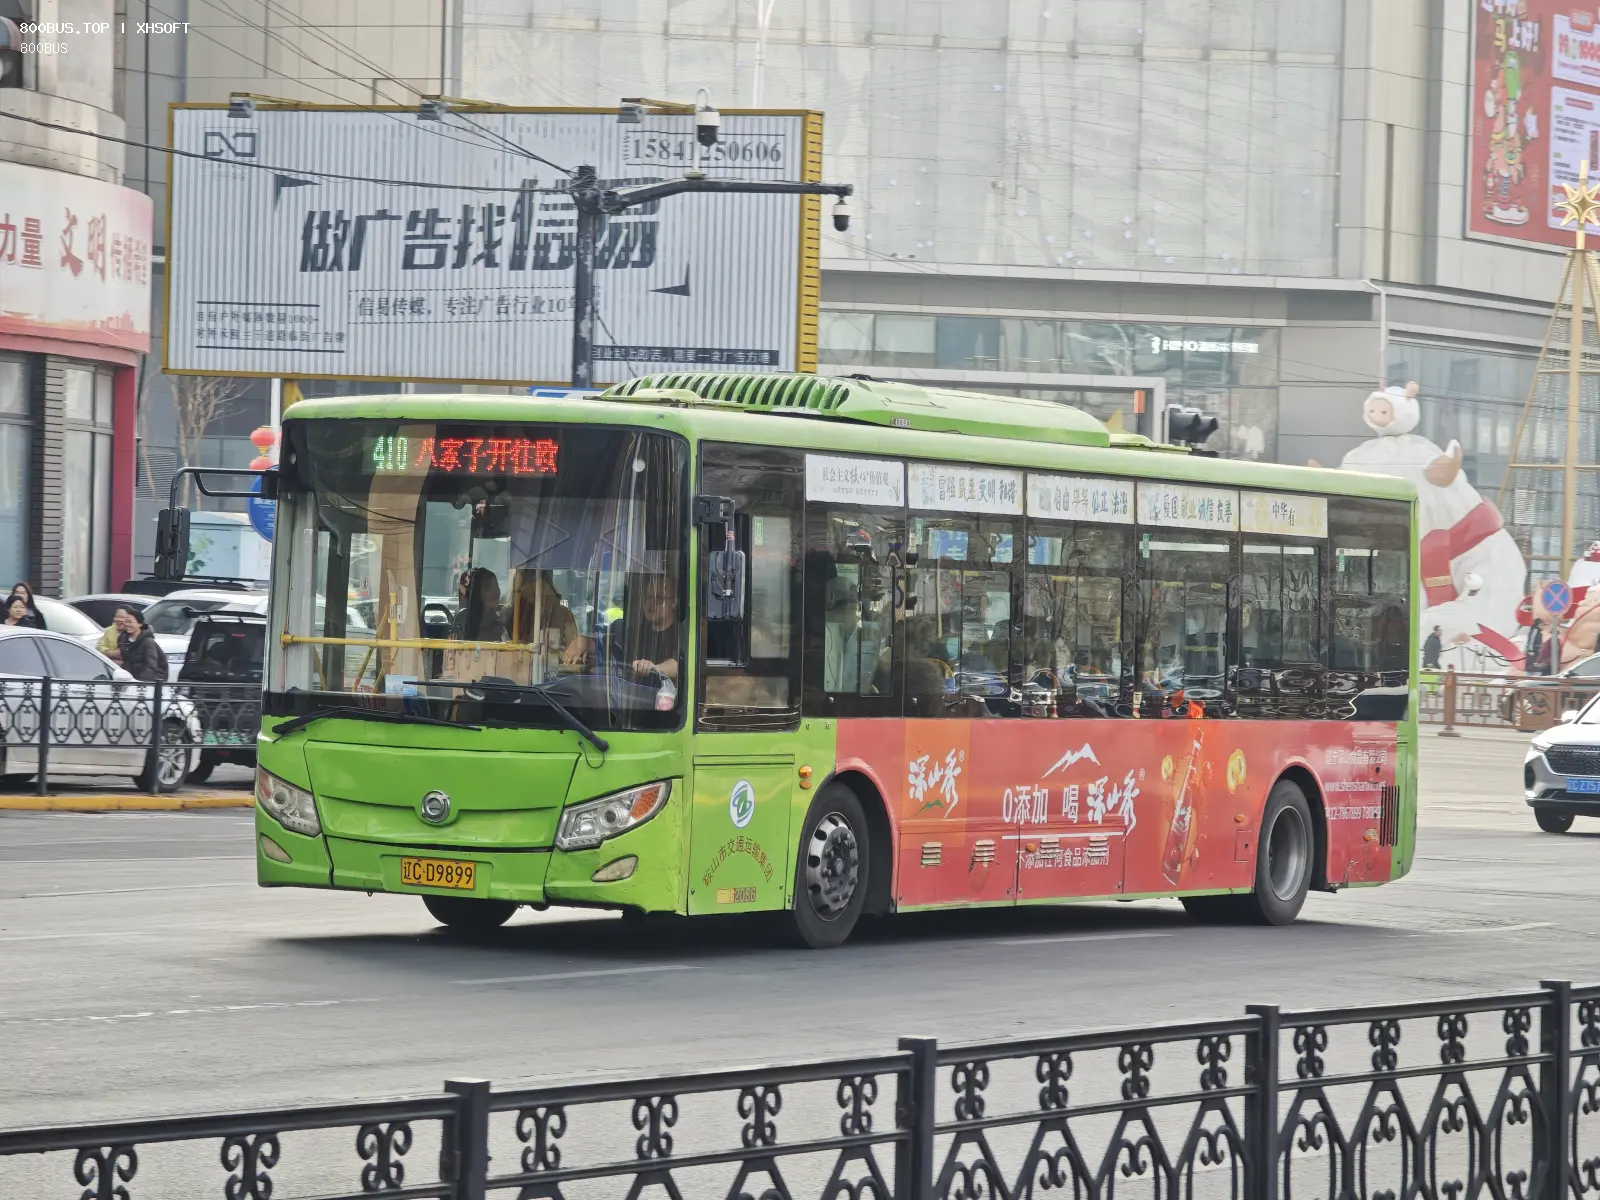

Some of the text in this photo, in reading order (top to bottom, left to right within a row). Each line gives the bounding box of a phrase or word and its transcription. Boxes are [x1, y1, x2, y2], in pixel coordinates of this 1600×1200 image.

[372, 434, 408, 470] 410
[1003, 784, 1049, 824] 0添加
[1062, 785, 1079, 823] 喝
[734, 887, 756, 903] 2086
